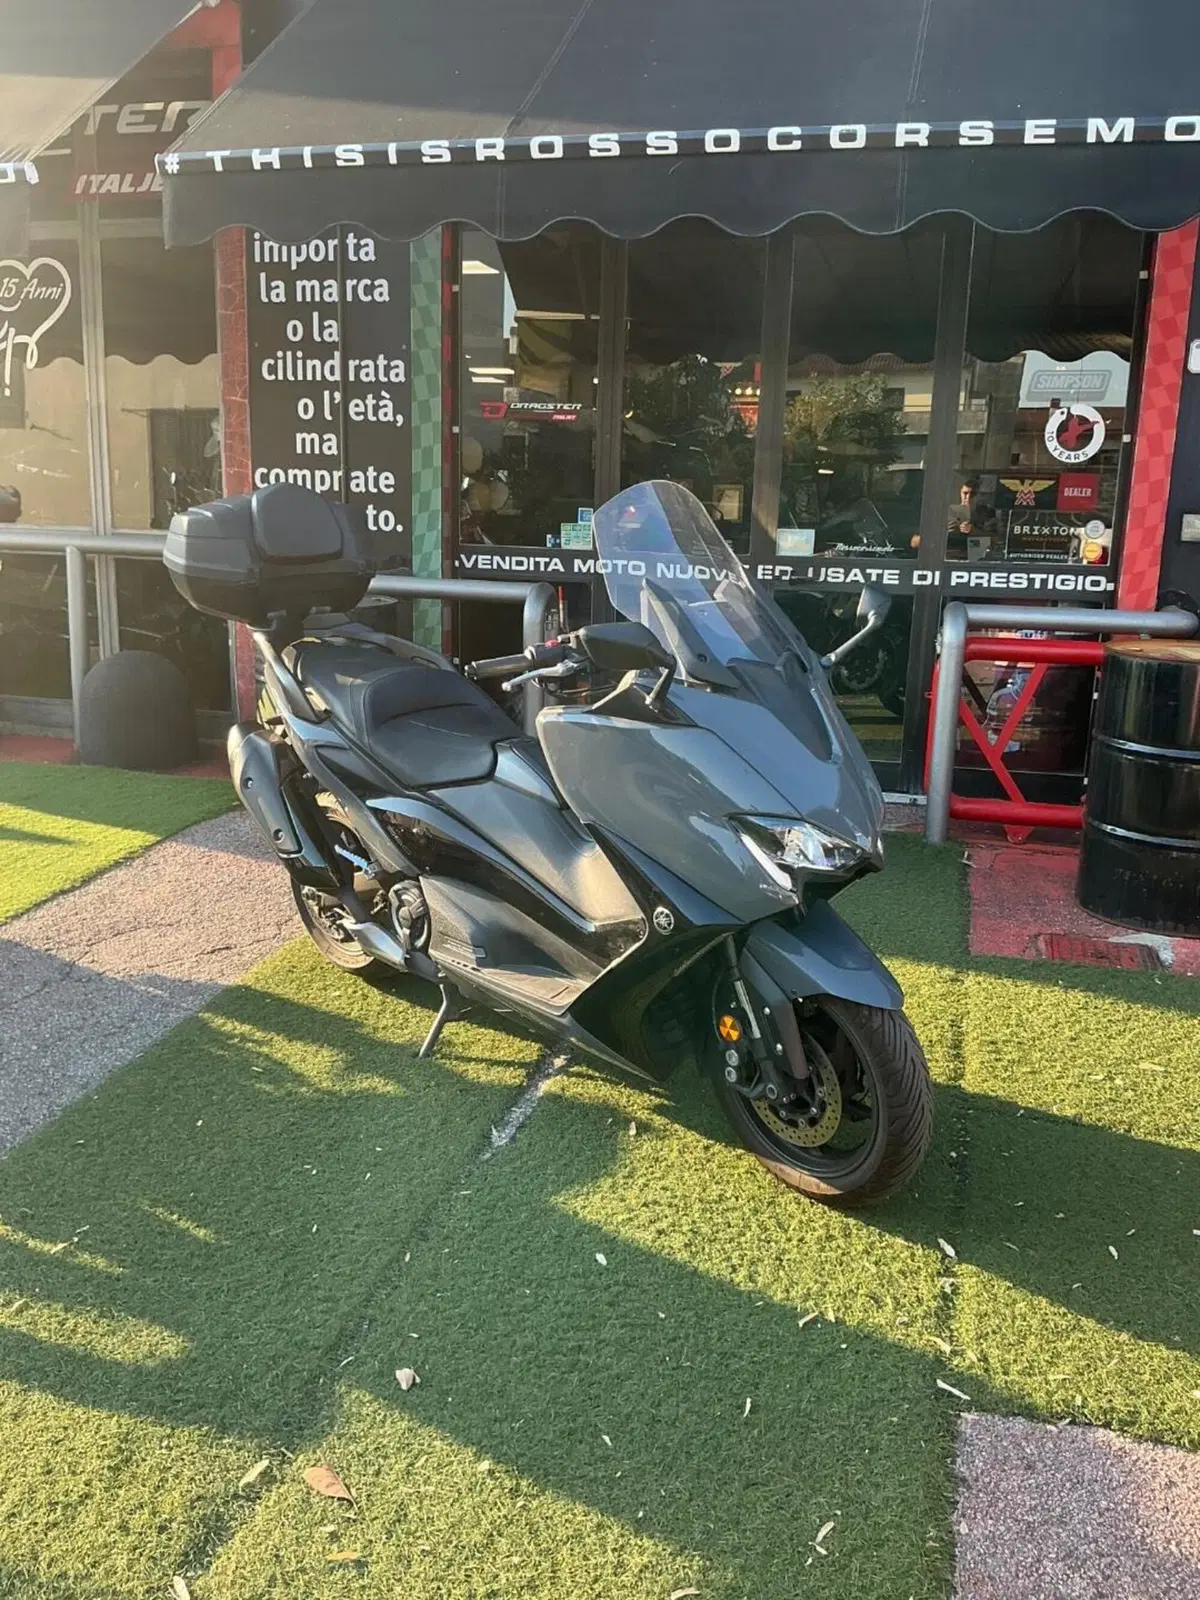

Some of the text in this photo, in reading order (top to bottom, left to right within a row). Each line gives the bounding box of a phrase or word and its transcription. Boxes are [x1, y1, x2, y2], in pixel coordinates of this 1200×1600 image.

[63, 101, 213, 136] TER
[0, 277, 64, 300] 15 Anni
[260, 272, 287, 303] la
[286, 311, 340, 343] o la
[1036, 373, 1104, 389] SIMPSON
[297, 397, 315, 420] o
[510, 402, 582, 411] DRAGSTER
[295, 431, 338, 456] ma
[1052, 445, 1089, 461] YEARS
[1063, 487, 1093, 497] DEALER
[366, 504, 404, 533] to.
[1013, 525, 1078, 536] BRIXTON
[573, 558, 646, 576] MOTO
[912, 570, 940, 586] DI
